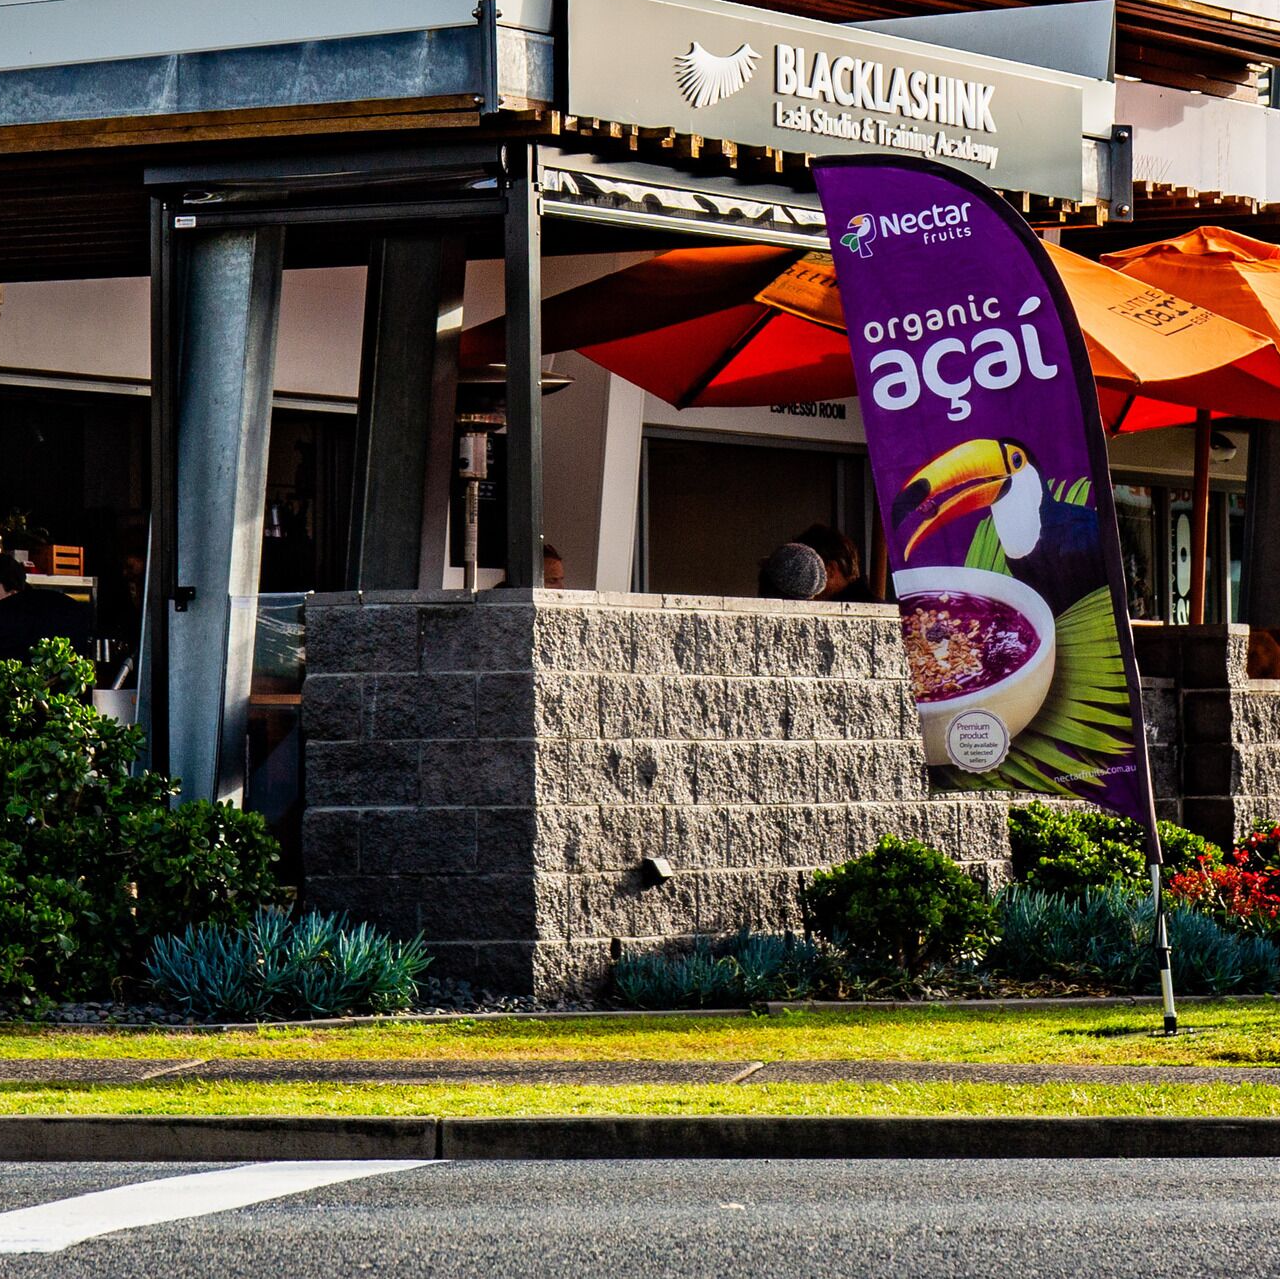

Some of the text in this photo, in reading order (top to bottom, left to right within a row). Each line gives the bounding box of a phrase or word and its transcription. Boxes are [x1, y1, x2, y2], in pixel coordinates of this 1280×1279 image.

[775, 43, 998, 133] BLACKLASHINK
[775, 101, 999, 170] Lash Studio & Training Academy
[879, 202, 972, 238] Nectar
[923, 226, 972, 245] fruits
[1119, 290, 1162, 311] LITTLE
[863, 294, 1001, 344] organic
[870, 296, 1058, 422] açaí
[770, 402, 846, 420] ESPRESSO ROOM
[957, 722, 990, 731] Premium
[960, 731, 989, 741] product
[1053, 764, 1137, 783] nectarfruits.com.au
